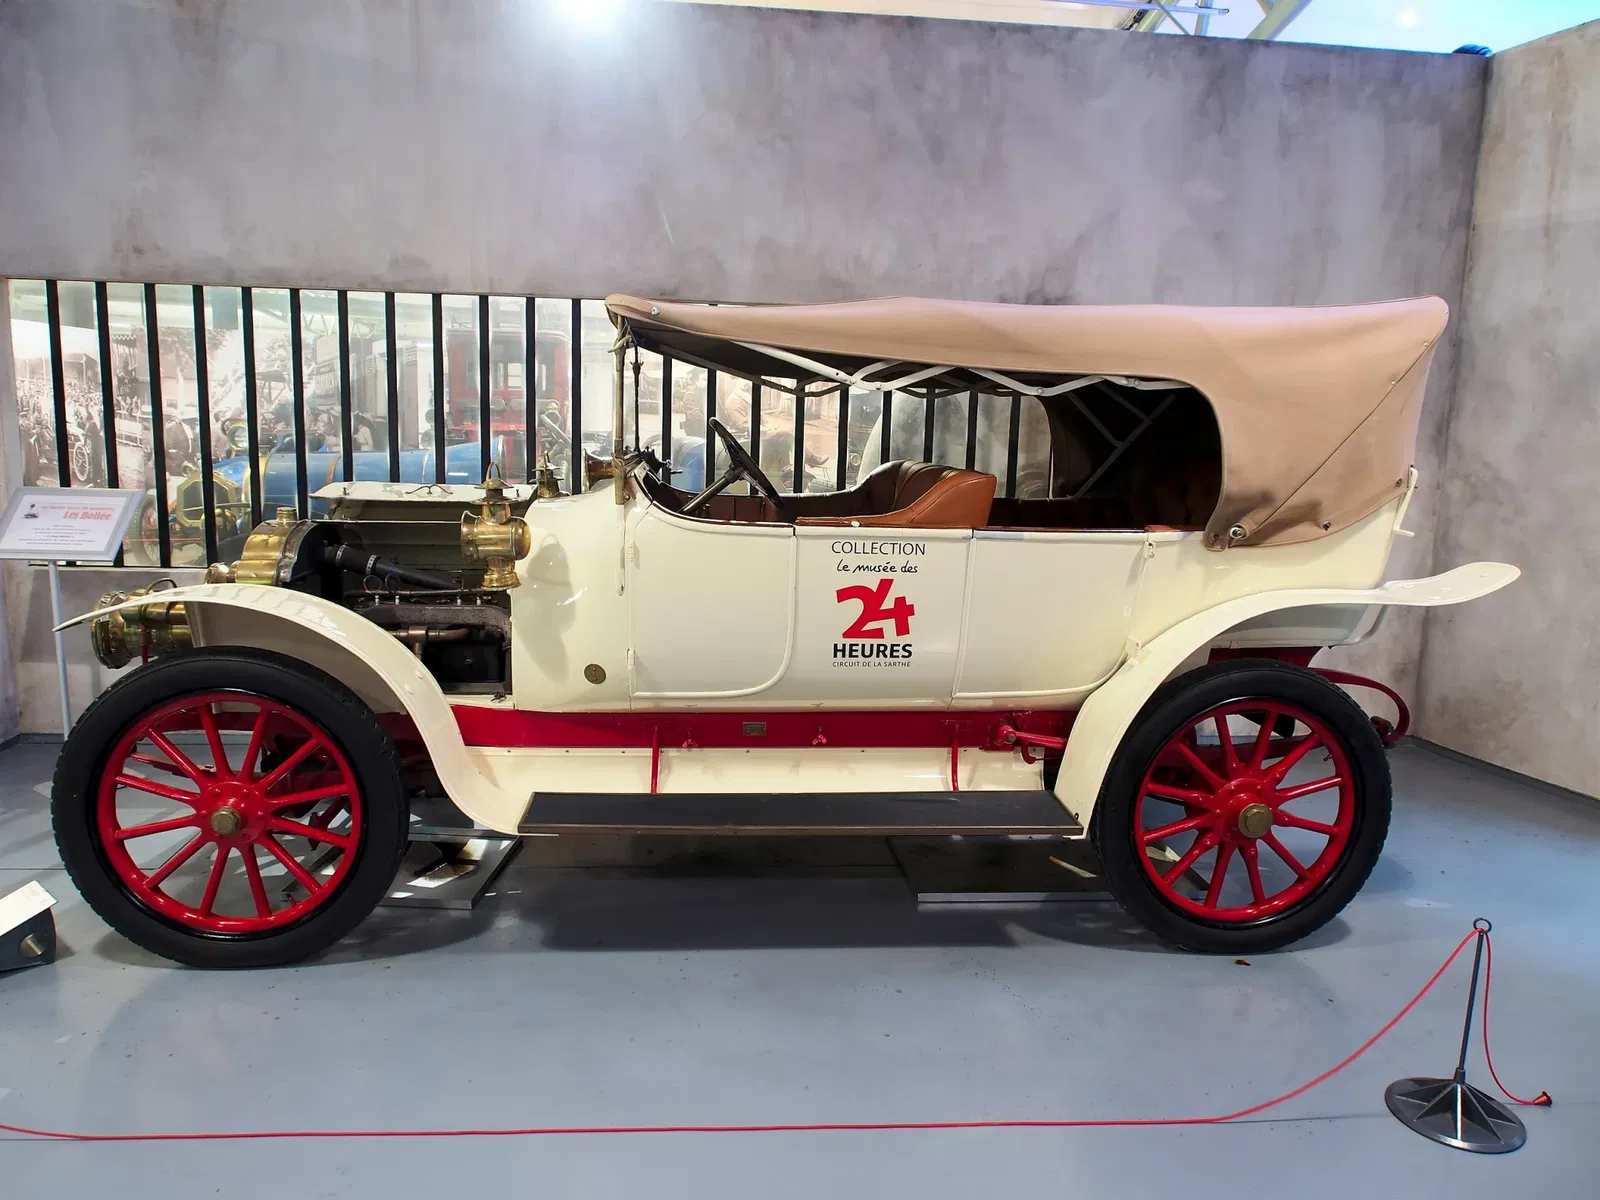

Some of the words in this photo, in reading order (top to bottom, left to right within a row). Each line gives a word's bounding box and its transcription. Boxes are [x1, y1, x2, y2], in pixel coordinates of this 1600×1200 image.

[832, 541, 926, 555] COLLECTION
[853, 562, 897, 573] musée
[901, 560, 918, 573] des
[836, 578, 915, 639] 24
[833, 643, 912, 658] HEURES
